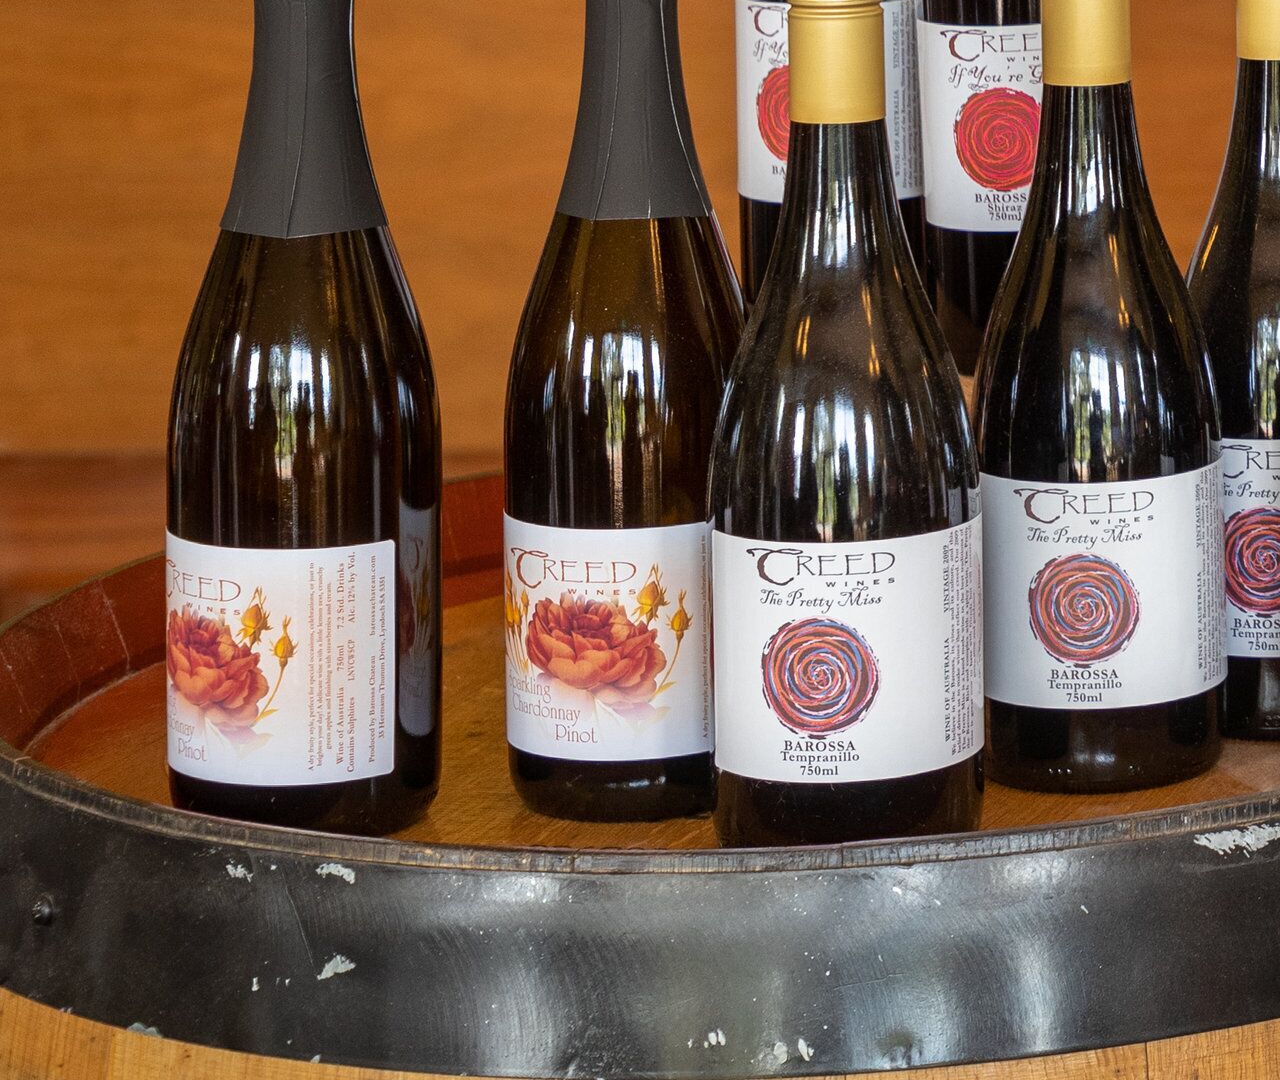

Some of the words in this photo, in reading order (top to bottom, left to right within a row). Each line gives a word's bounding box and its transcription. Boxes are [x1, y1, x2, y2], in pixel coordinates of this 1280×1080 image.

[939, 29, 1042, 62] CREE
[1006, 55, 1040, 63] WIN
[974, 192, 1027, 204] BAROSS
[987, 203, 1023, 213] Shiraz
[988, 211, 1022, 221] 750ml
[1236, 480, 1280, 505] Pretty
[1013, 487, 1155, 524] CREED
[1089, 514, 1154, 525] WINES
[1026, 525, 1050, 543] The
[1052, 525, 1098, 550] Pretty
[1101, 523, 1144, 543] Miss
[348, 550, 356, 569] Vol.
[745, 546, 896, 586] CREED
[510, 547, 637, 589] CREED
[348, 571, 357, 582] by
[825, 577, 895, 588] WINES
[567, 588, 637, 596] WINES
[759, 589, 783, 606] The
[785, 588, 834, 614] Pretty
[837, 586, 883, 607] Miss
[1050, 669, 1119, 680] BAROSSA
[508, 669, 552, 704] Sparkling
[1047, 679, 1122, 693] Tempranillo
[944, 696, 950, 710] OF
[1066, 692, 1103, 703] 750ml
[336, 686, 344, 726] Australia
[511, 693, 581, 727] Chardonnay
[347, 696, 356, 734] Sulphites
[369, 716, 376, 726] by
[336, 728, 344, 738] of
[555, 724, 598, 744] Pinot
[177, 737, 208, 762] Pinot
[336, 740, 344, 764] Wine
[784, 740, 856, 752] BAROSSA
[780, 750, 860, 766] Tempranillo
[799, 765, 839, 776] 750ml
